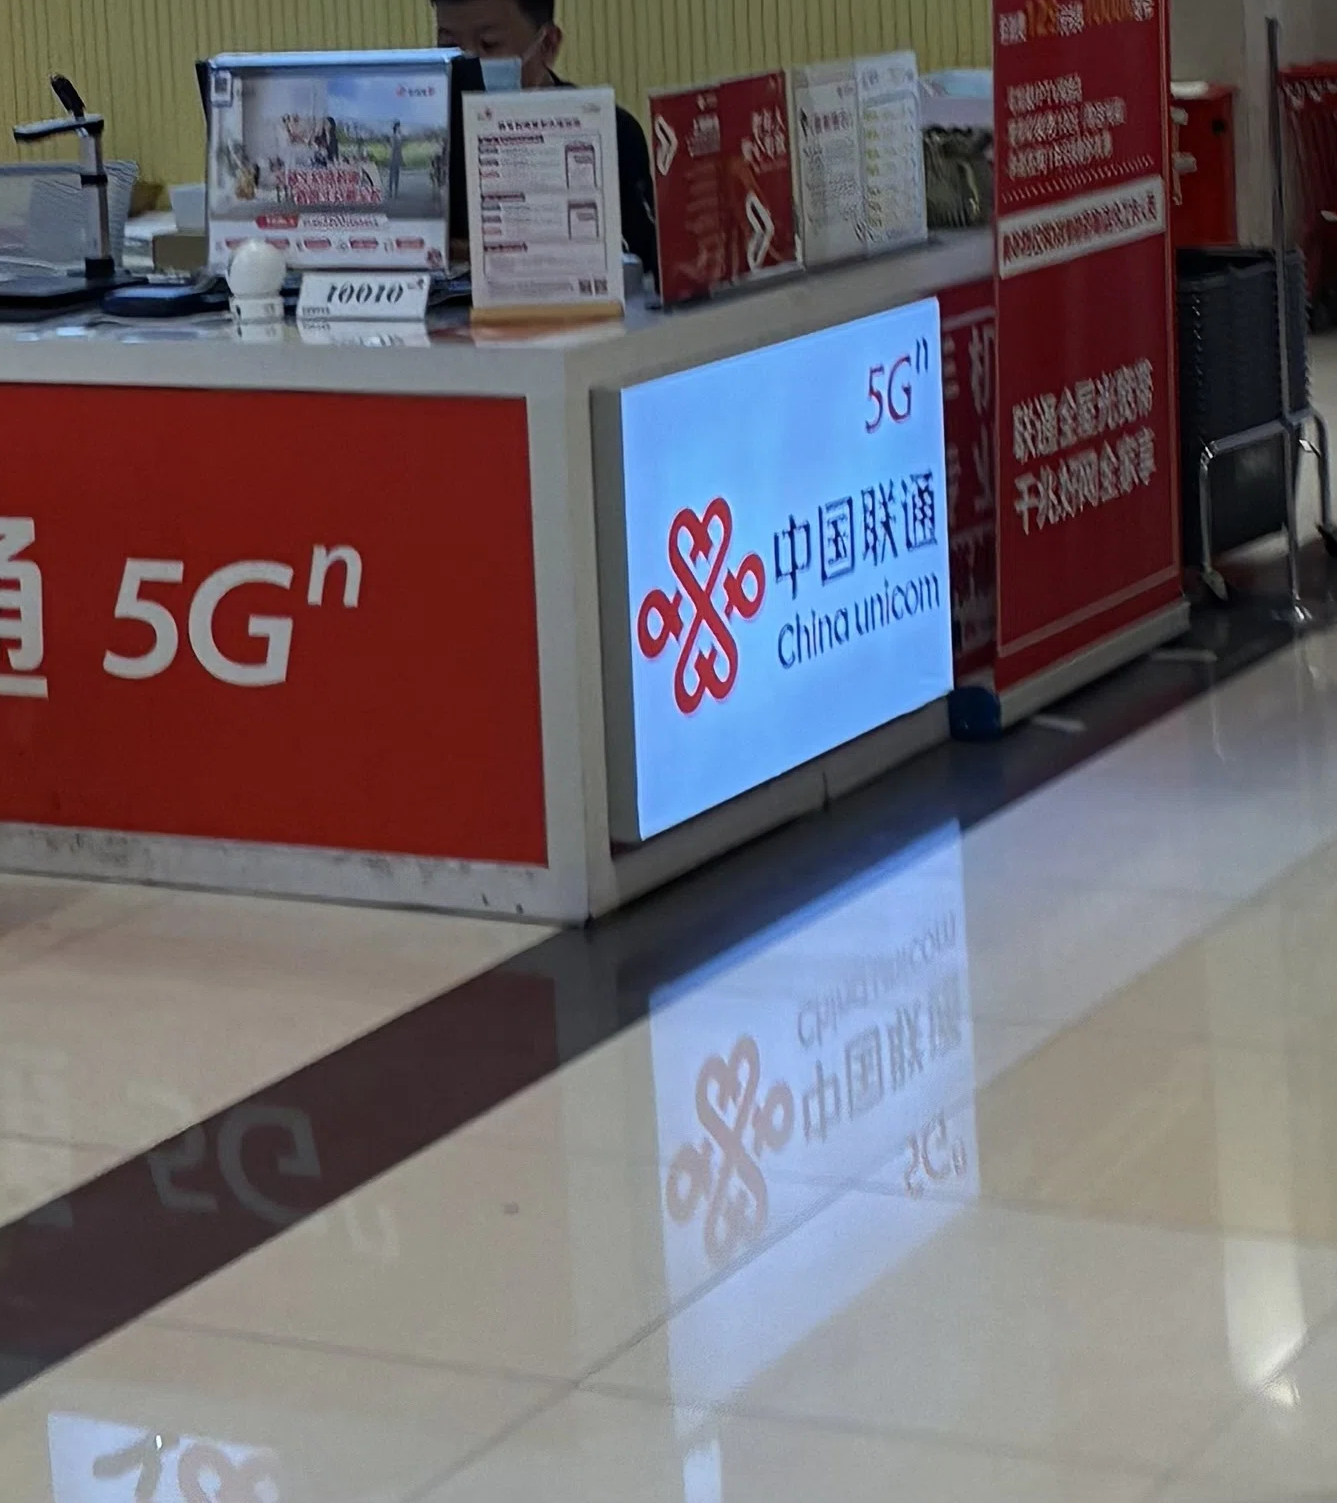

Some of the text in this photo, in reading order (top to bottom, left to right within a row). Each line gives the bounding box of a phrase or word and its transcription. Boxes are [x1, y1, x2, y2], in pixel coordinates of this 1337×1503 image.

[326, 282, 405, 305] 10010
[773, 467, 938, 600] 中国联通
